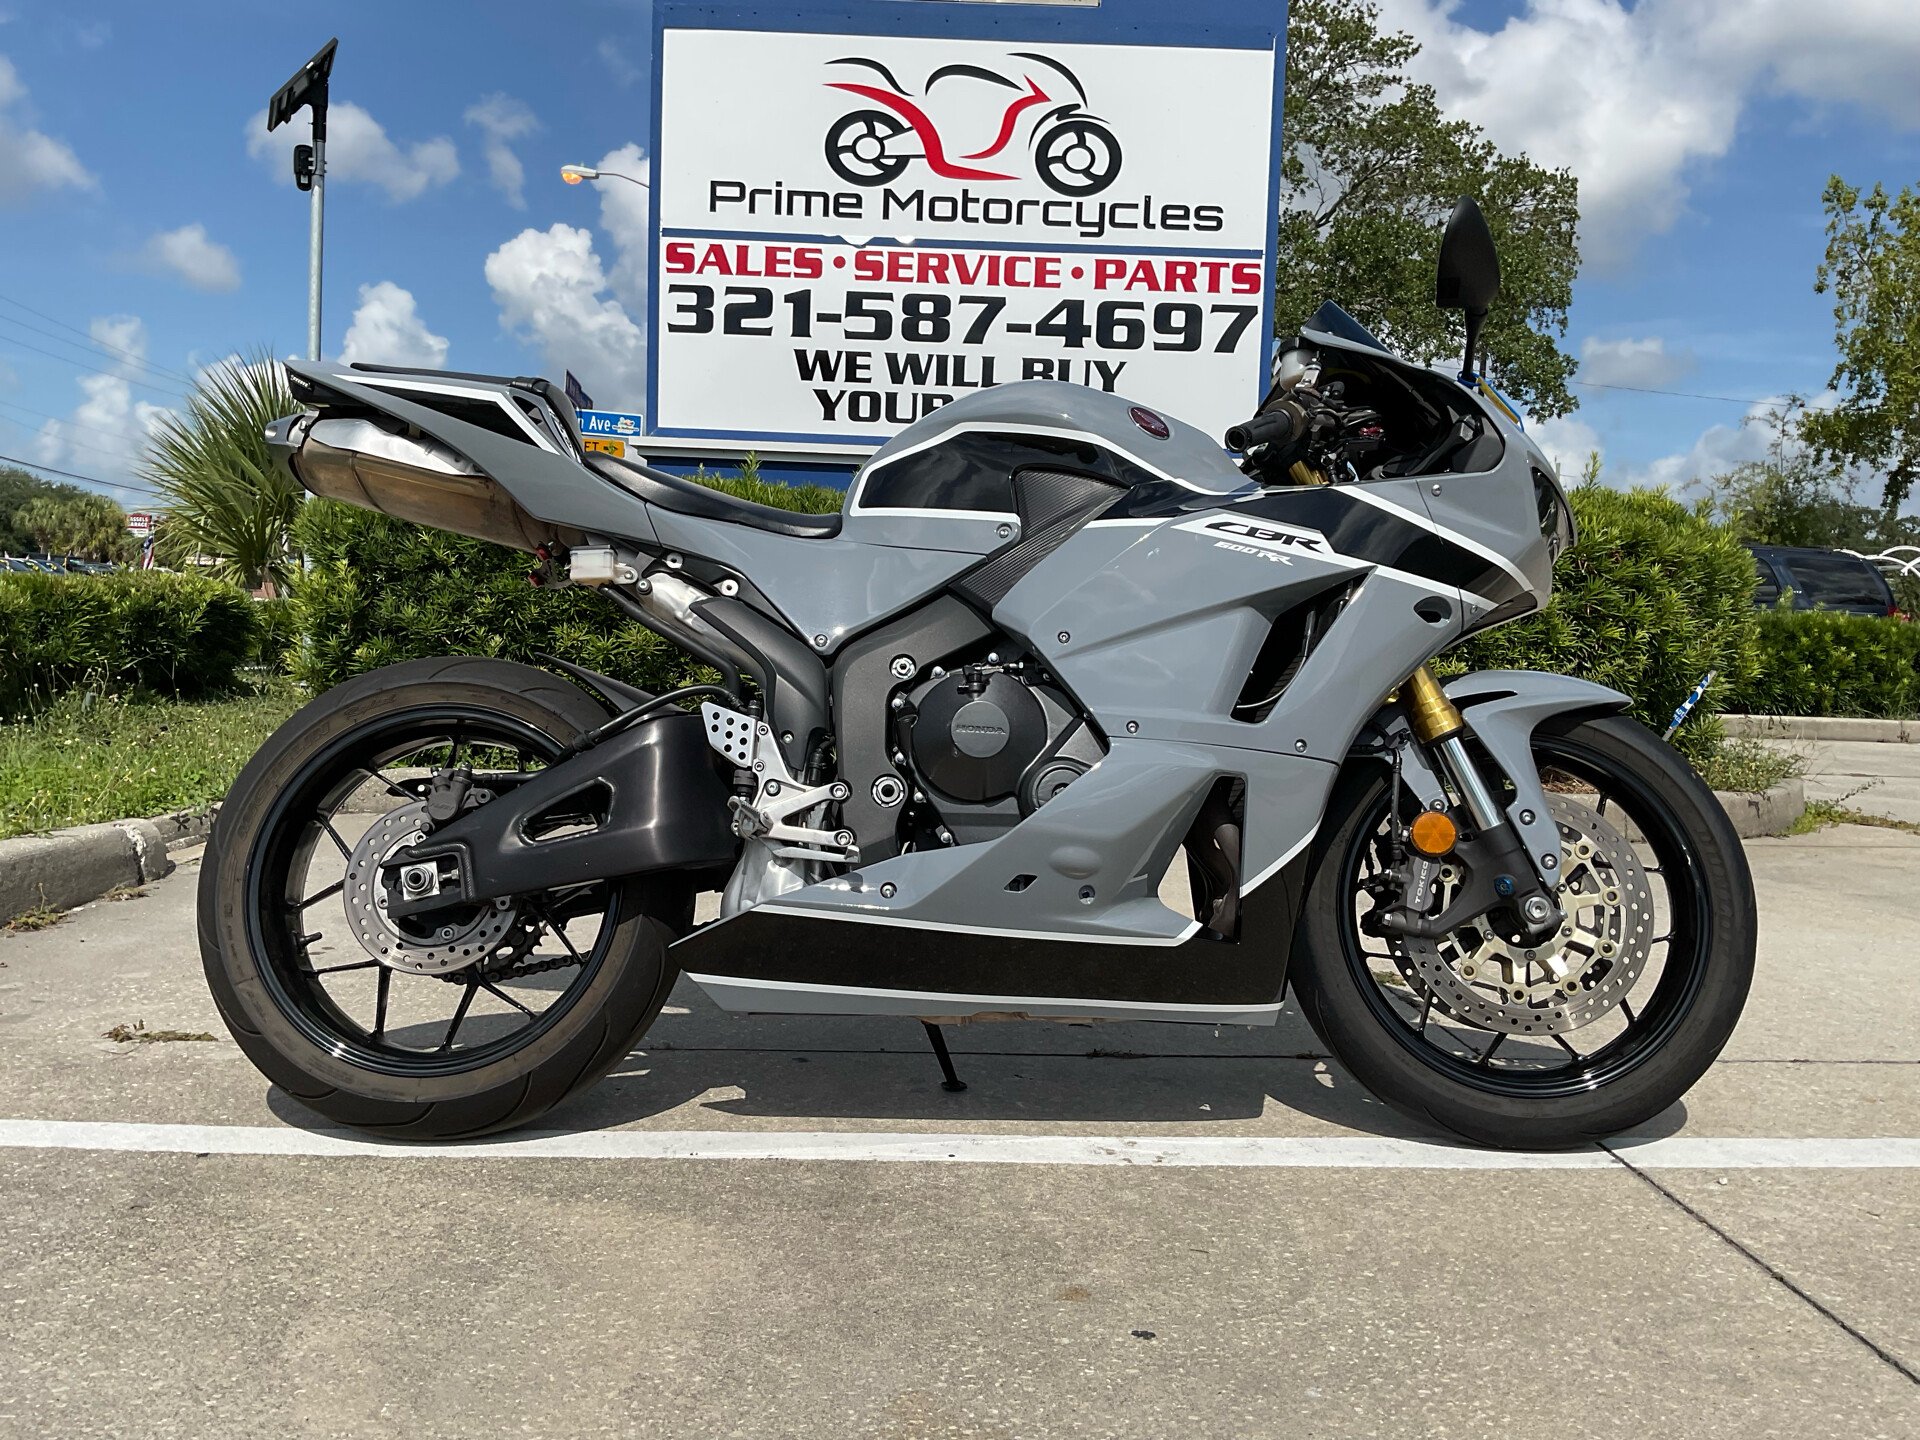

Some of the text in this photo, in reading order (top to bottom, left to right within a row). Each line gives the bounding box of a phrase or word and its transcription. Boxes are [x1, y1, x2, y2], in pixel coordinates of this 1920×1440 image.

[709, 180, 1224, 238] Prime Motorcycles
[665, 242, 1262, 295] SALES SERVICE PARTS
[667, 284, 1259, 354] 321-587-4697
[793, 349, 872, 383] WE
[884, 352, 1003, 388] WILL
[589, 415, 611, 431] Ave
[1204, 521, 1324, 554] CBR
[955, 723, 1006, 735] HONDA
[1414, 860, 1429, 904] TOKICO
